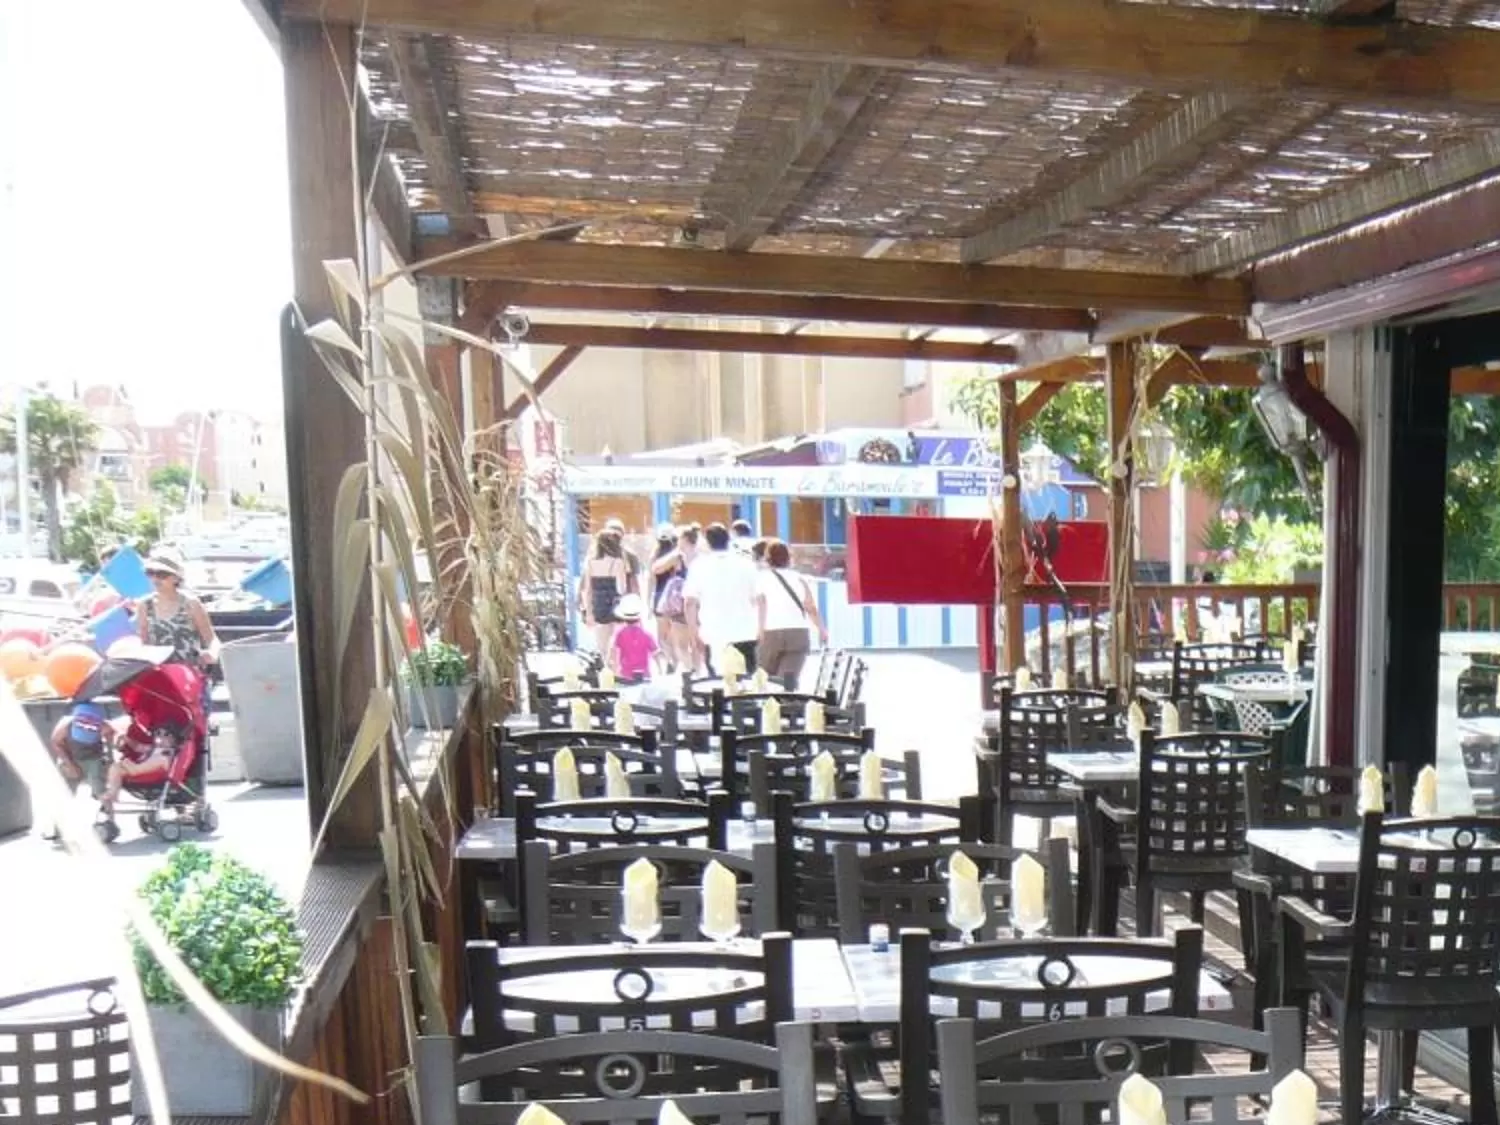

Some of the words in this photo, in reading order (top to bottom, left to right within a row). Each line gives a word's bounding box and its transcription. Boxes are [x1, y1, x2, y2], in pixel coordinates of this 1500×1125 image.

[671, 475, 721, 490] CUISINE
[726, 475, 776, 490] MINUTE
[1049, 1003, 1062, 1021] 6
[629, 1017, 644, 1032] 5
